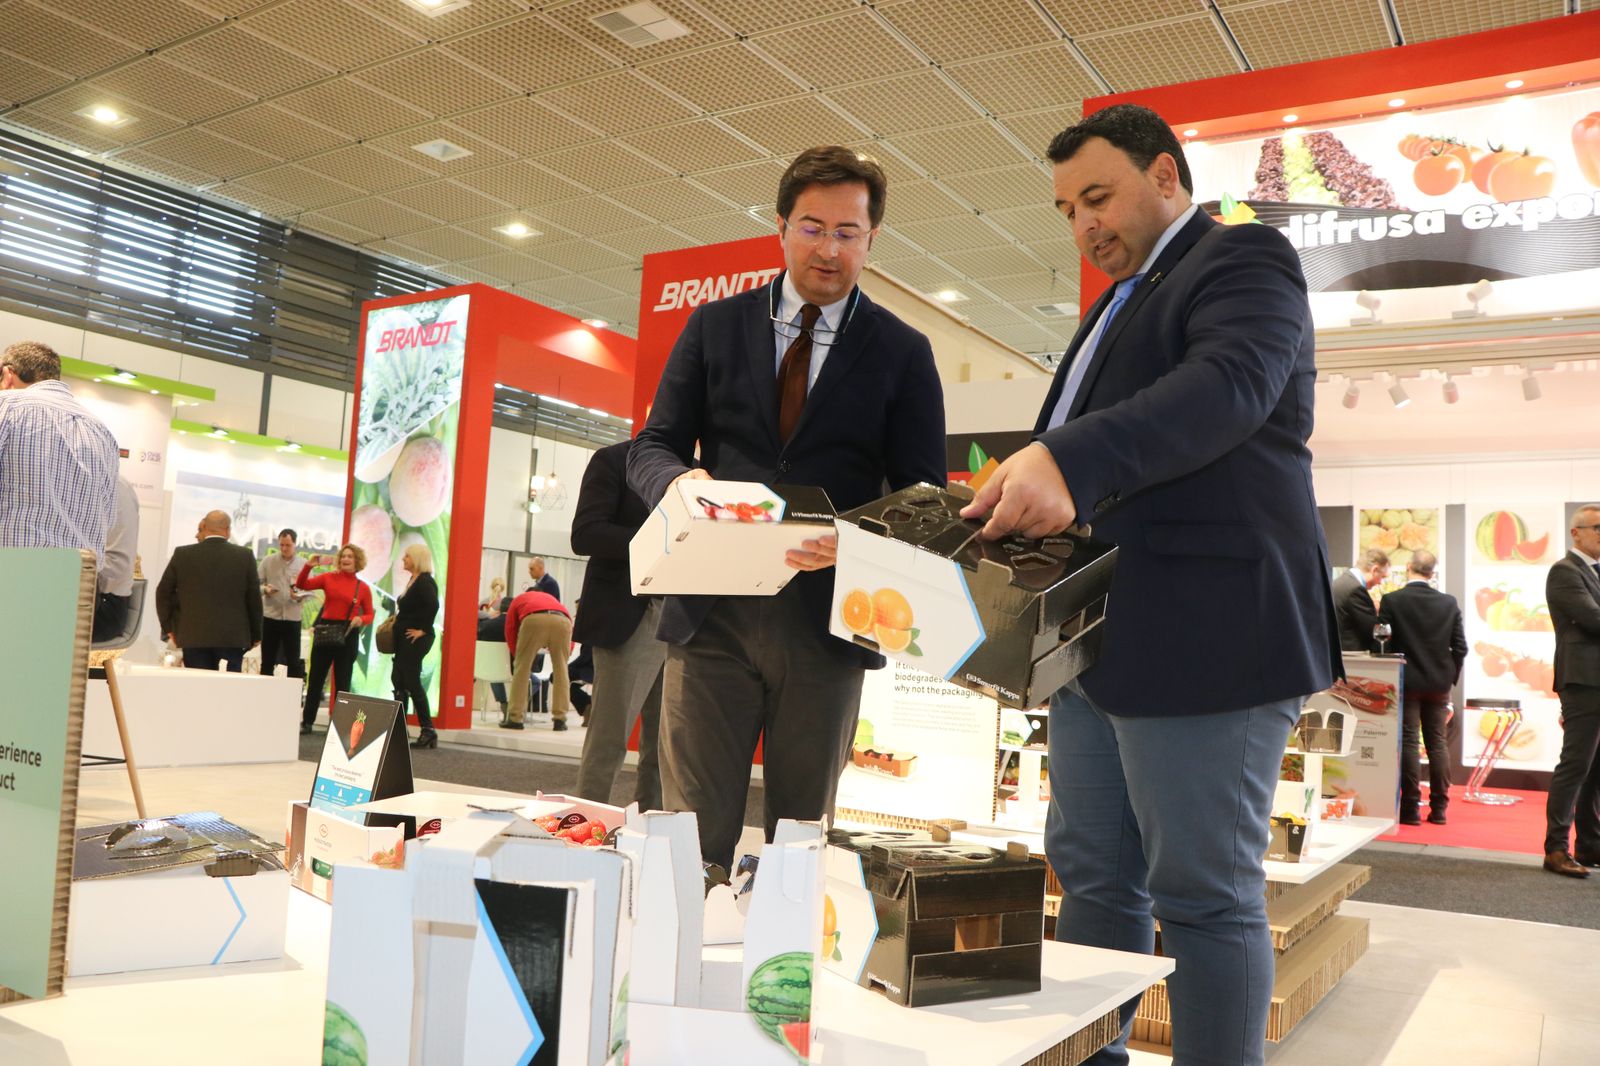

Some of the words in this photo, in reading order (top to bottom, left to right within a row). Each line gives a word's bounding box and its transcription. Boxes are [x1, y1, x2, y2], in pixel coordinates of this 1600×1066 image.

[1279, 208, 1446, 250] difrusa
[376, 320, 458, 353] BRANDT
[894, 684, 911, 694] why
[927, 686, 940, 694] the
[976, 677, 1001, 692] Smurfit
[1000, 687, 1020, 700] Kappa
